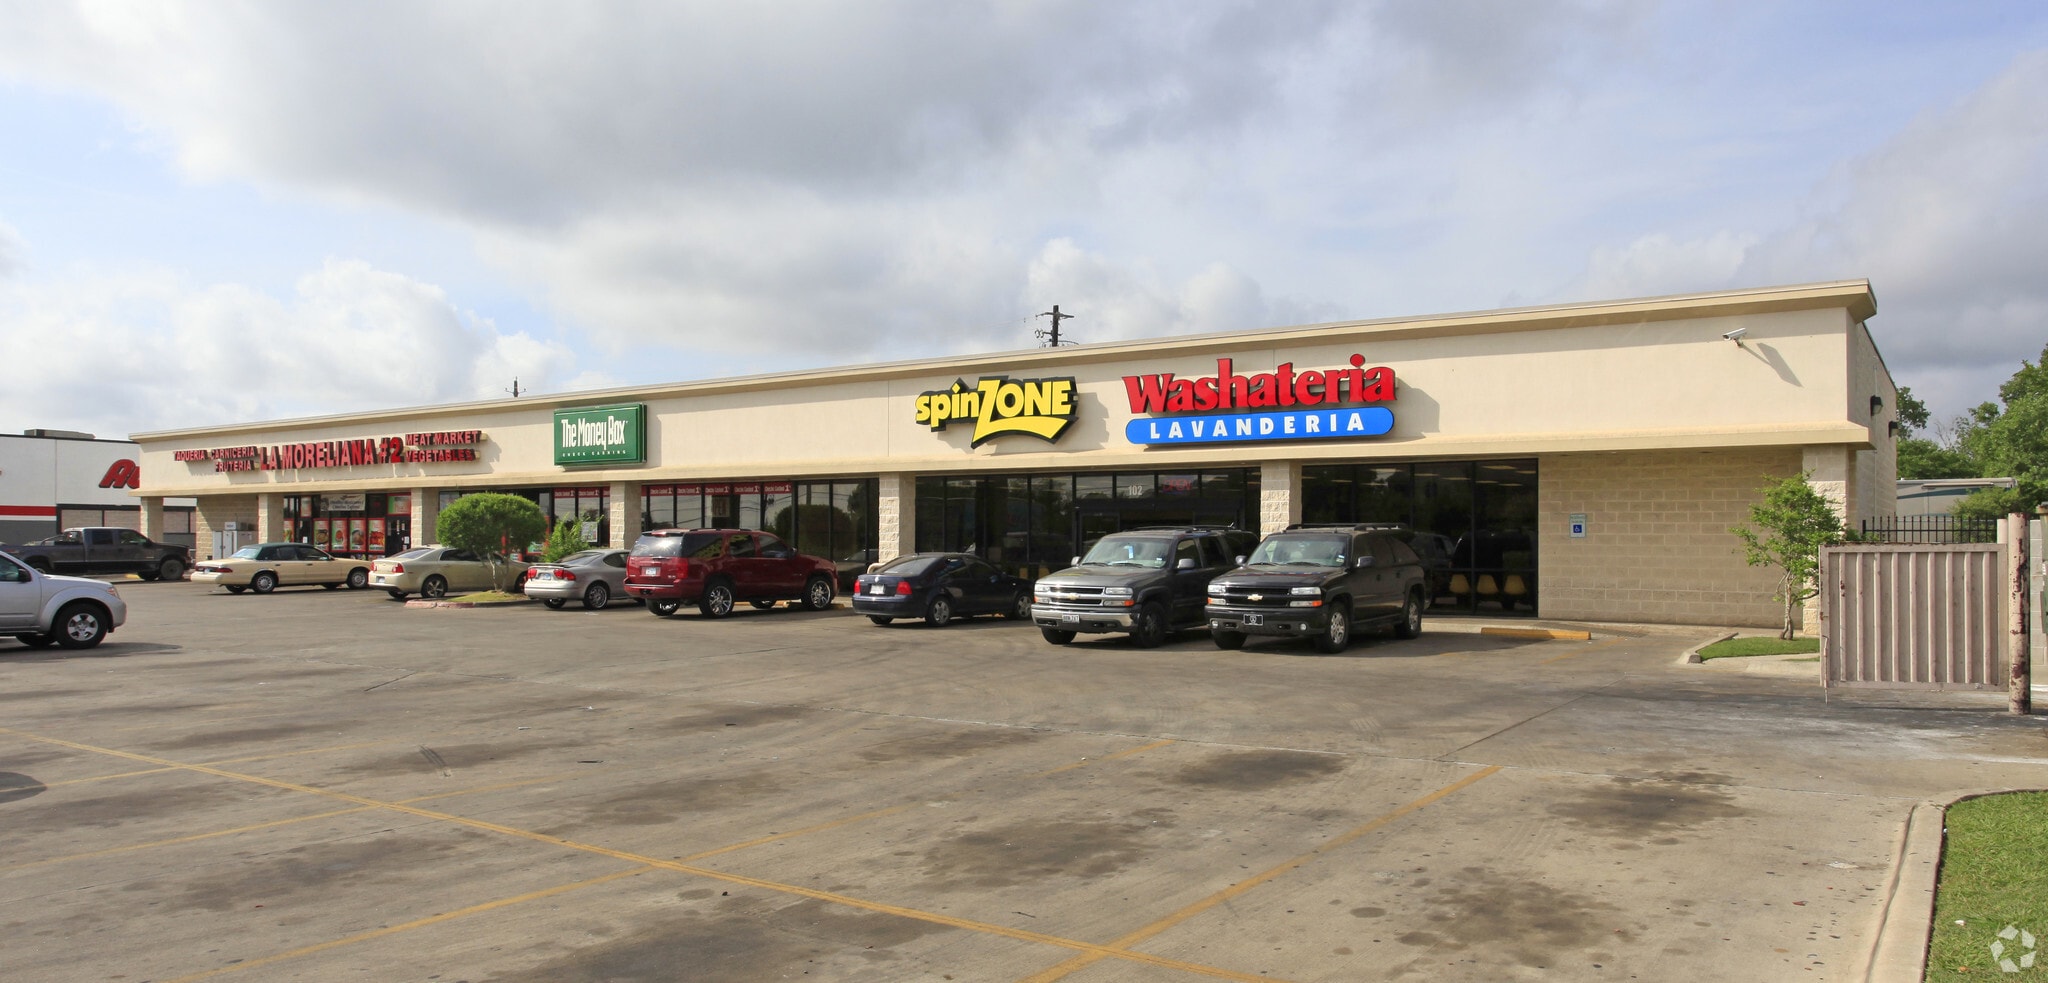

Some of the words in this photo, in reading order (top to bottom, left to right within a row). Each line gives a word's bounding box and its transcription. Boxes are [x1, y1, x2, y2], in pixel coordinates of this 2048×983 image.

[1121, 353, 1397, 414] Washateria
[561, 418, 577, 448] The
[577, 417, 607, 451] Money
[608, 415, 625, 445] Box
[1150, 412, 1365, 439] LAVANDERIA
[405, 433, 433, 446] MEAT
[433, 430, 480, 445] MARKET
[210, 446, 256, 460] CARNICERIA
[259, 446, 279, 471] LA
[282, 438, 374, 470] MORELIANA
[378, 436, 404, 464] #2
[405, 448, 475, 463] VEGETABLES
[215, 460, 252, 472] FRUTERIA
[1128, 485, 1143, 496] 102
